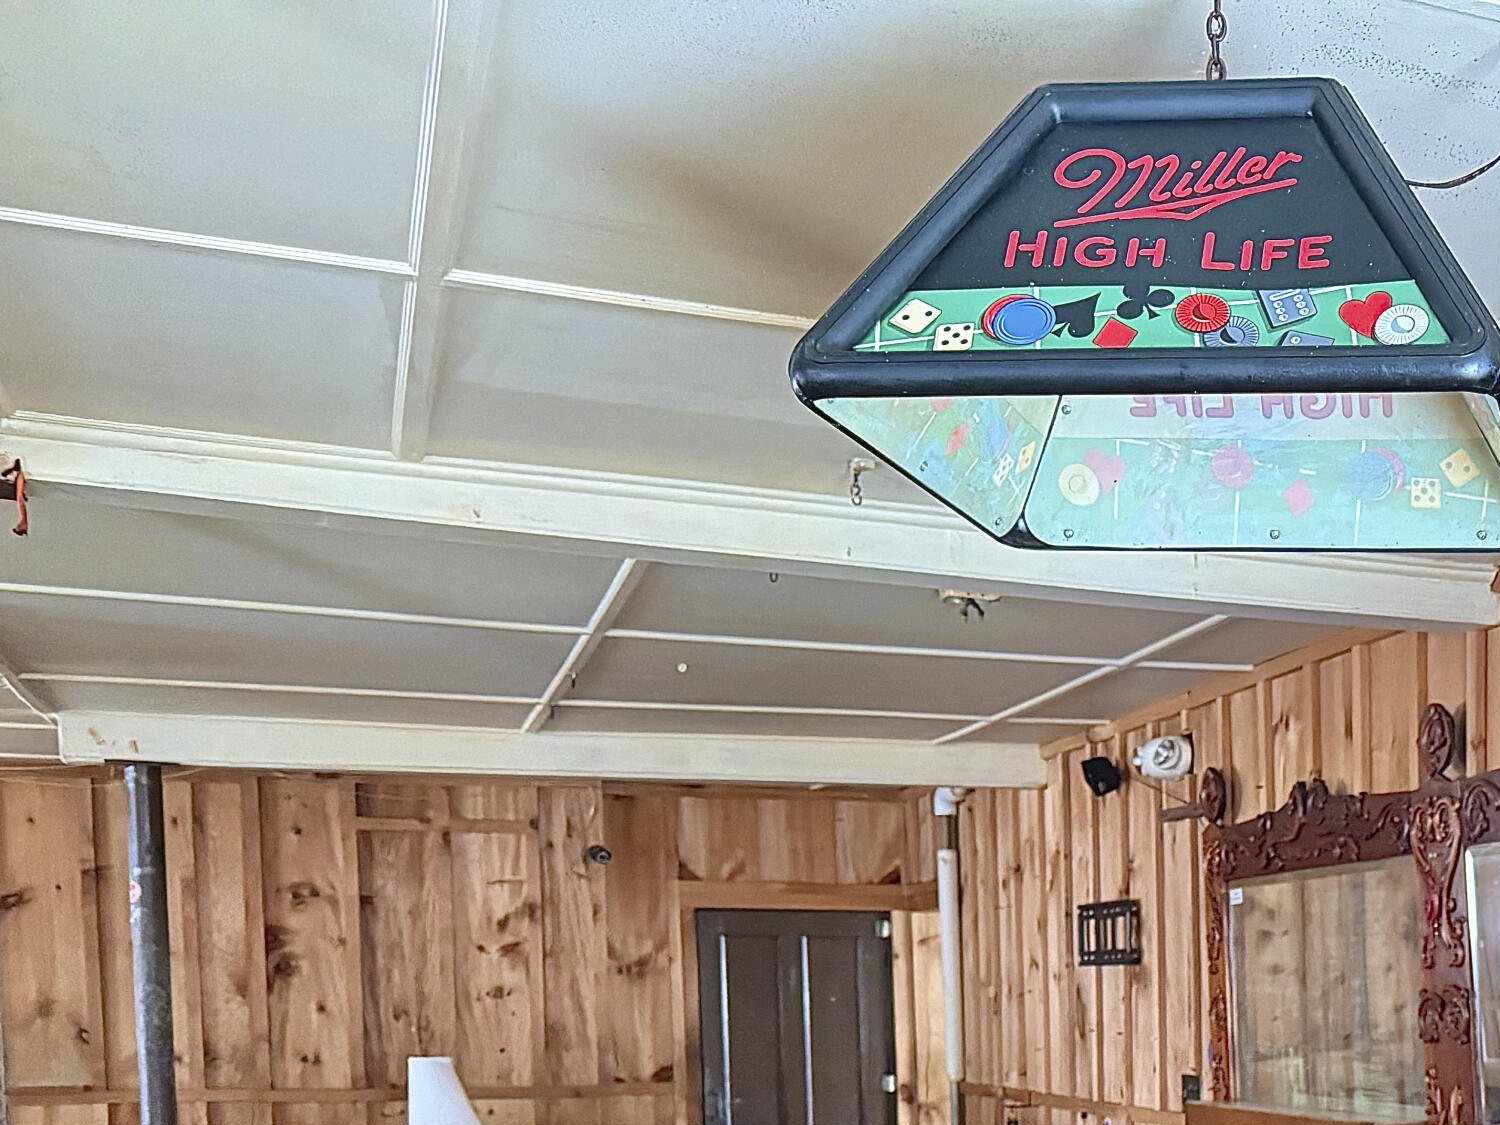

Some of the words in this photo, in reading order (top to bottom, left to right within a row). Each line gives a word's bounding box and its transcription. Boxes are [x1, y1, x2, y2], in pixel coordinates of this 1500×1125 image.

[1053, 148, 1303, 214] Miller
[1003, 230, 1168, 269] HIGH
[1201, 232, 1333, 271] LIFE
